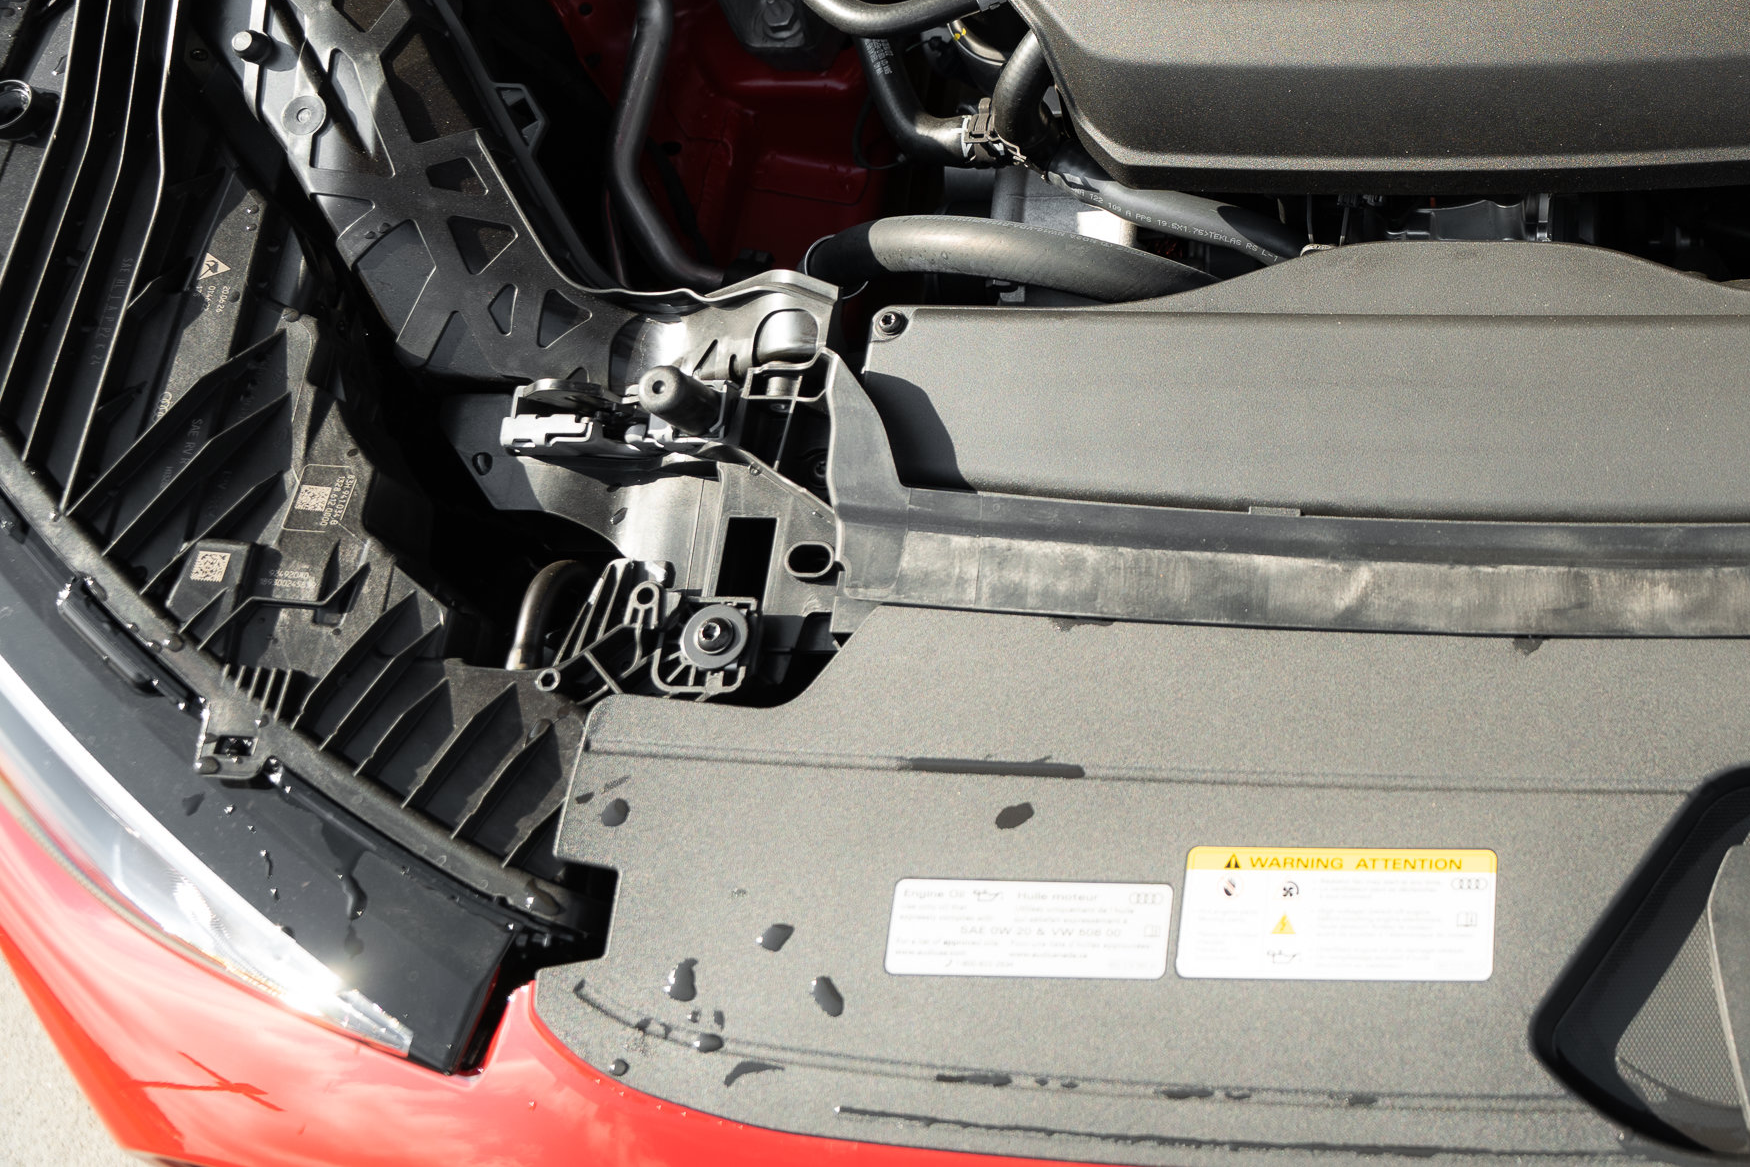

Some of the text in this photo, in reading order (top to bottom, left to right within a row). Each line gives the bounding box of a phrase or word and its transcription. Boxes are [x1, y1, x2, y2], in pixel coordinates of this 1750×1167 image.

[1250, 857, 1463, 871] WARNING ATTENTION
[903, 889, 965, 900] Engine Oil
[1017, 892, 1098, 901] Huile moteur
[960, 926, 985, 934] SAE
[990, 926, 1010, 934] 0W
[1015, 926, 1031, 934] 20
[1036, 926, 1044, 935] &
[1051, 927, 1074, 936] VW
[1105, 928, 1121, 936] 00
